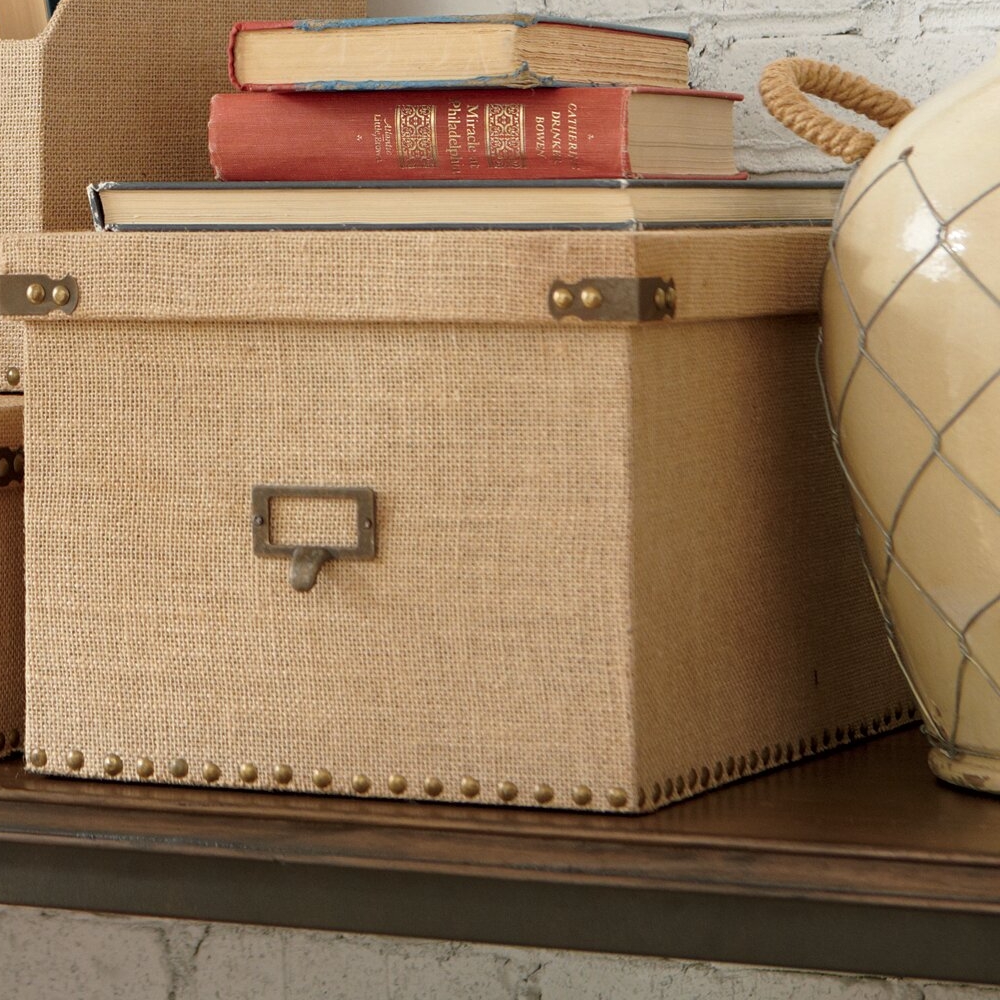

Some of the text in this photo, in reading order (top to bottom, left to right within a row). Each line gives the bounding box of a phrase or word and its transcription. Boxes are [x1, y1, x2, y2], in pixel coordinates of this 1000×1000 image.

[466, 104, 480, 153] Miracle
[535, 115, 546, 159] BOWEN
[567, 102, 580, 170] CATHERI
